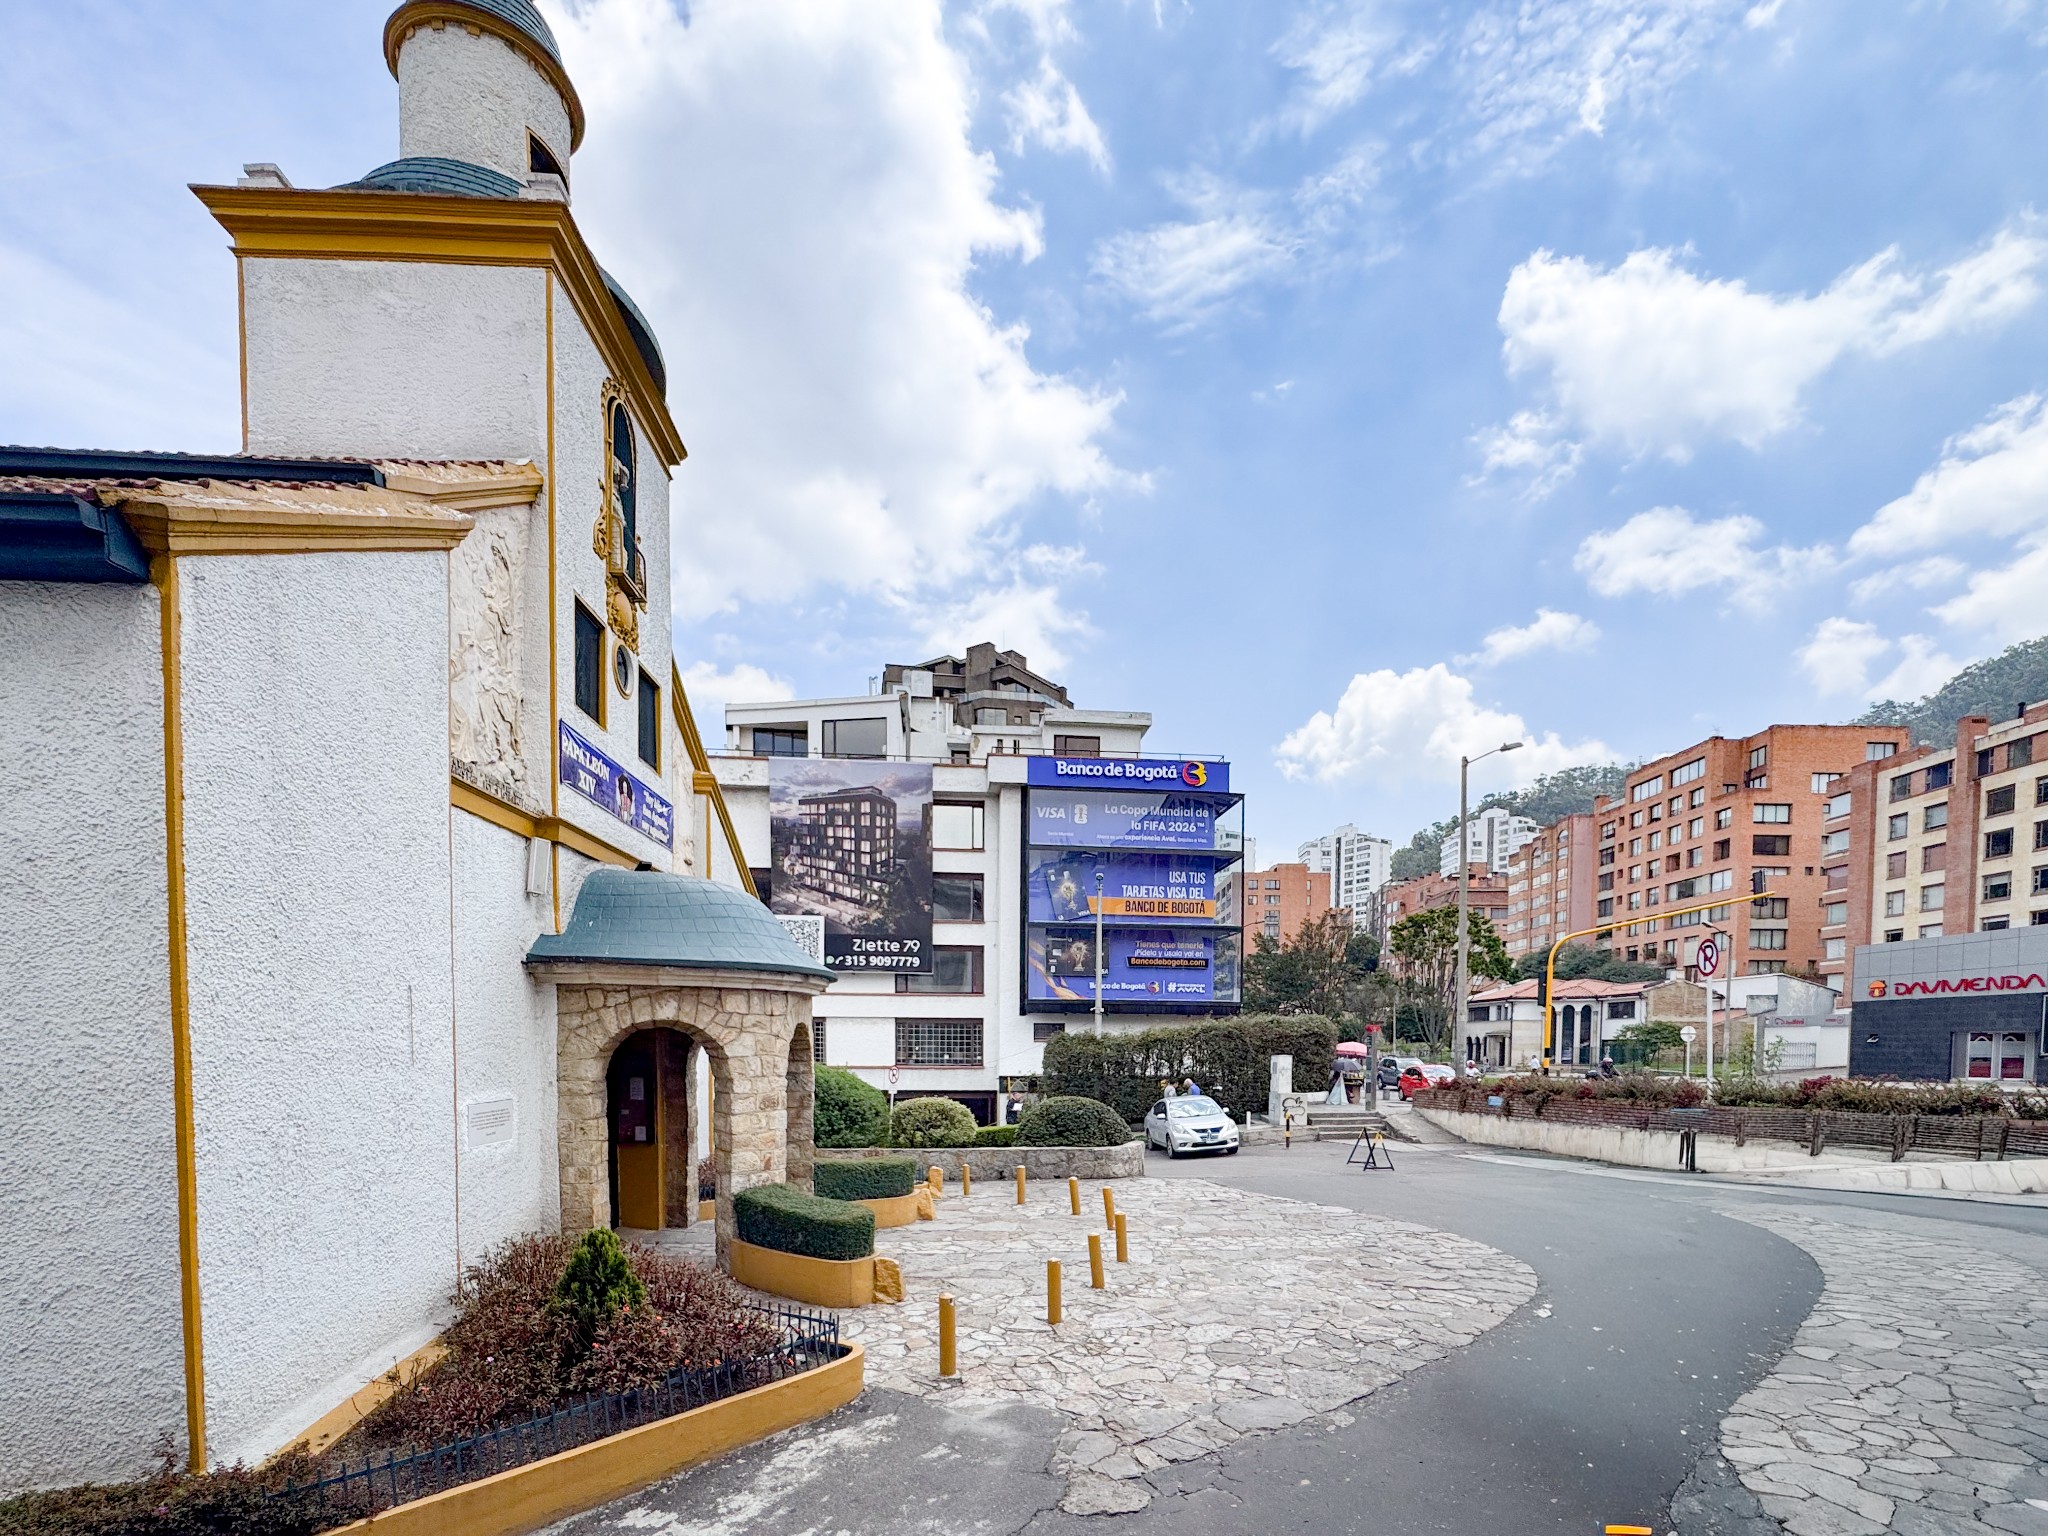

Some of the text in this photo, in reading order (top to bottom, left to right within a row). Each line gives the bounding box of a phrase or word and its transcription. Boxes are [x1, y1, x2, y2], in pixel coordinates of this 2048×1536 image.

[585, 748, 610, 783] LEÓN
[1056, 761, 1178, 781] Banco de Bogotá
[578, 768, 597, 796] XIV
[1036, 806, 1066, 819] VISA
[1104, 804, 1209, 818] La Copa Mundial de
[1131, 820, 1141, 831] la
[1143, 821, 1166, 831] FIFA
[1169, 871, 1206, 885] USA TUS
[1122, 885, 1206, 899] TARJETAS VISA DEL
[1125, 900, 1206, 914] BANCO DE BOGOTÁ
[852, 939, 921, 952] Ziette 79
[845, 955, 920, 967] 315 9097779
[1112, 982, 1121, 990] de
[1121, 982, 1146, 991] Bogotá
[1893, 973, 2046, 996] DAVIVIENDA
